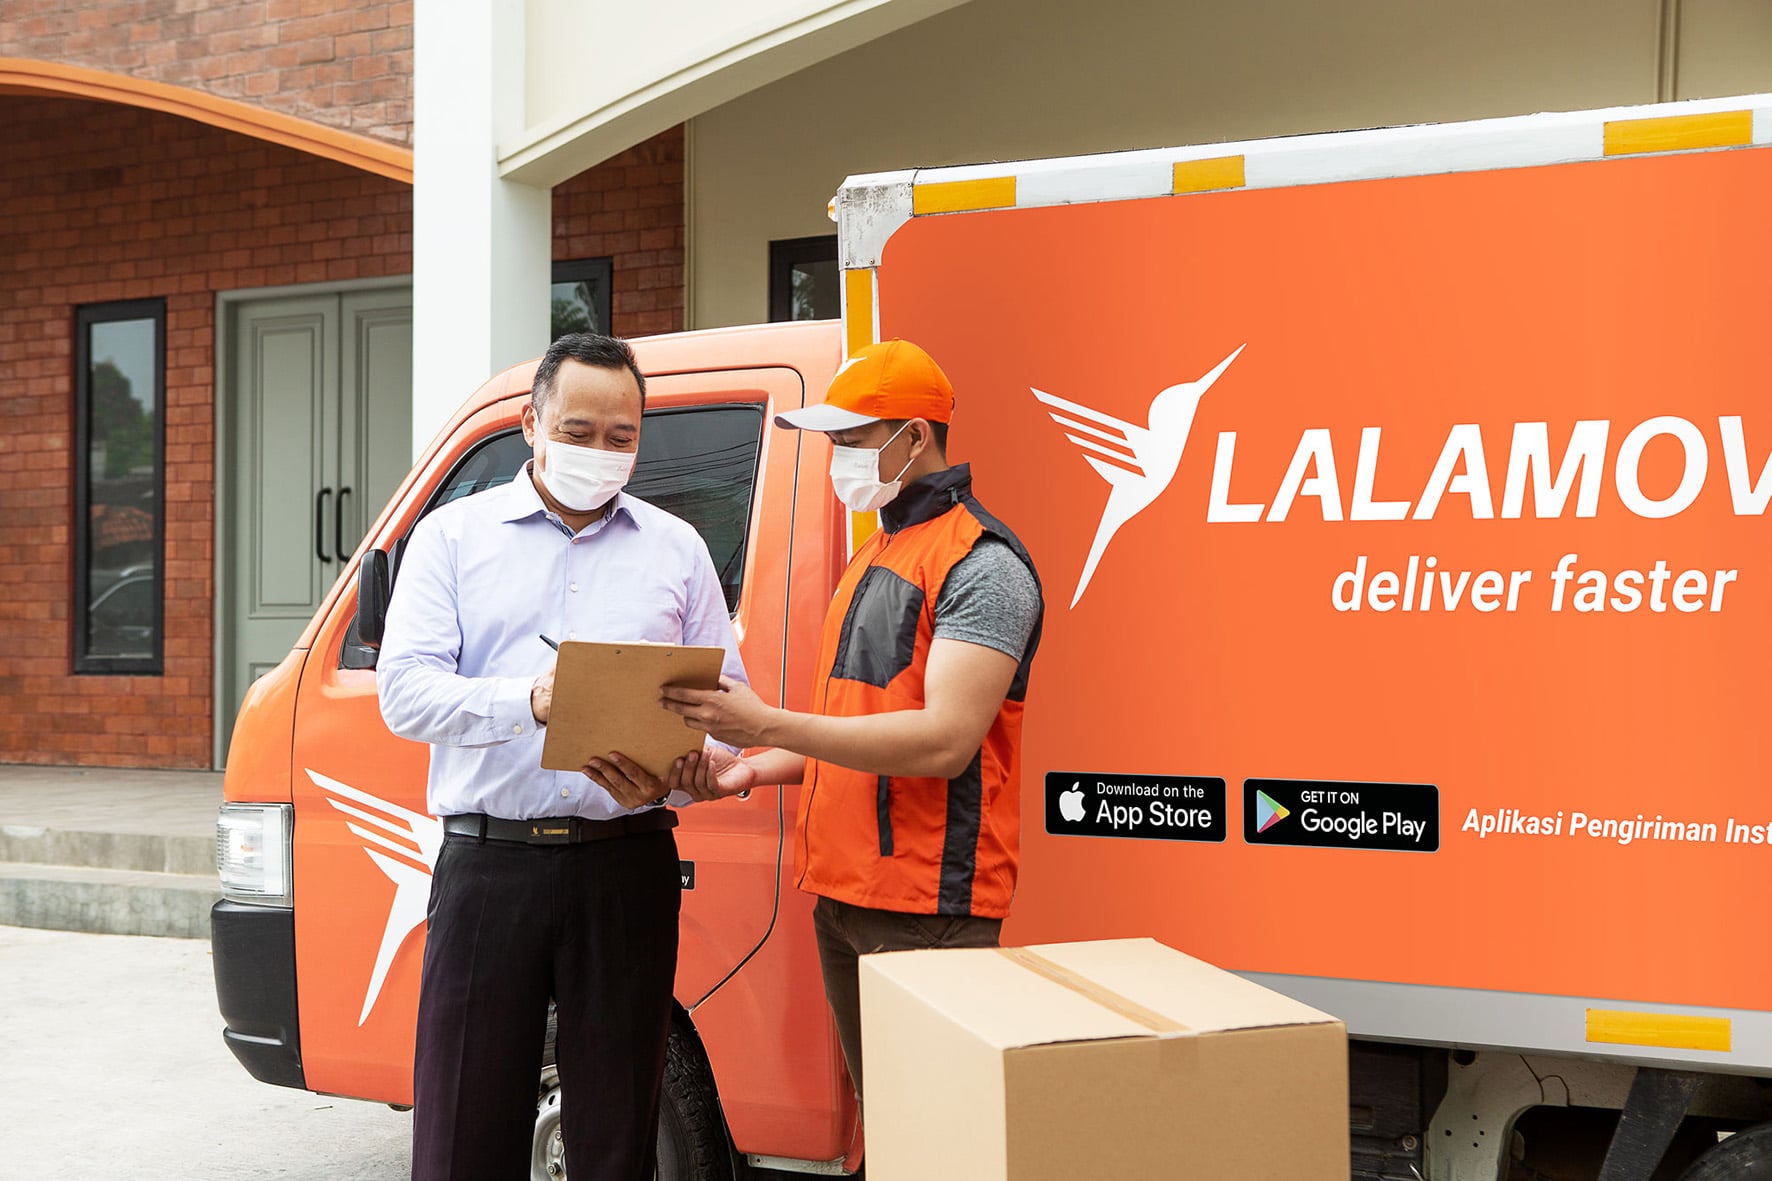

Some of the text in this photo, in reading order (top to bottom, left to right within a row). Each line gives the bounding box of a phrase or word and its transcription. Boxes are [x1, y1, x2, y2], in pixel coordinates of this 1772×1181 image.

[1332, 553, 1738, 613] deliver faster
[1096, 781, 1205, 799] Download on the
[1300, 790, 1359, 805] GET IT ON
[1096, 799, 1212, 830] App Store
[1300, 808, 1427, 843] Google Play
[1461, 808, 1563, 839] Aplikasi
[1569, 812, 1717, 845] Pengiriman
